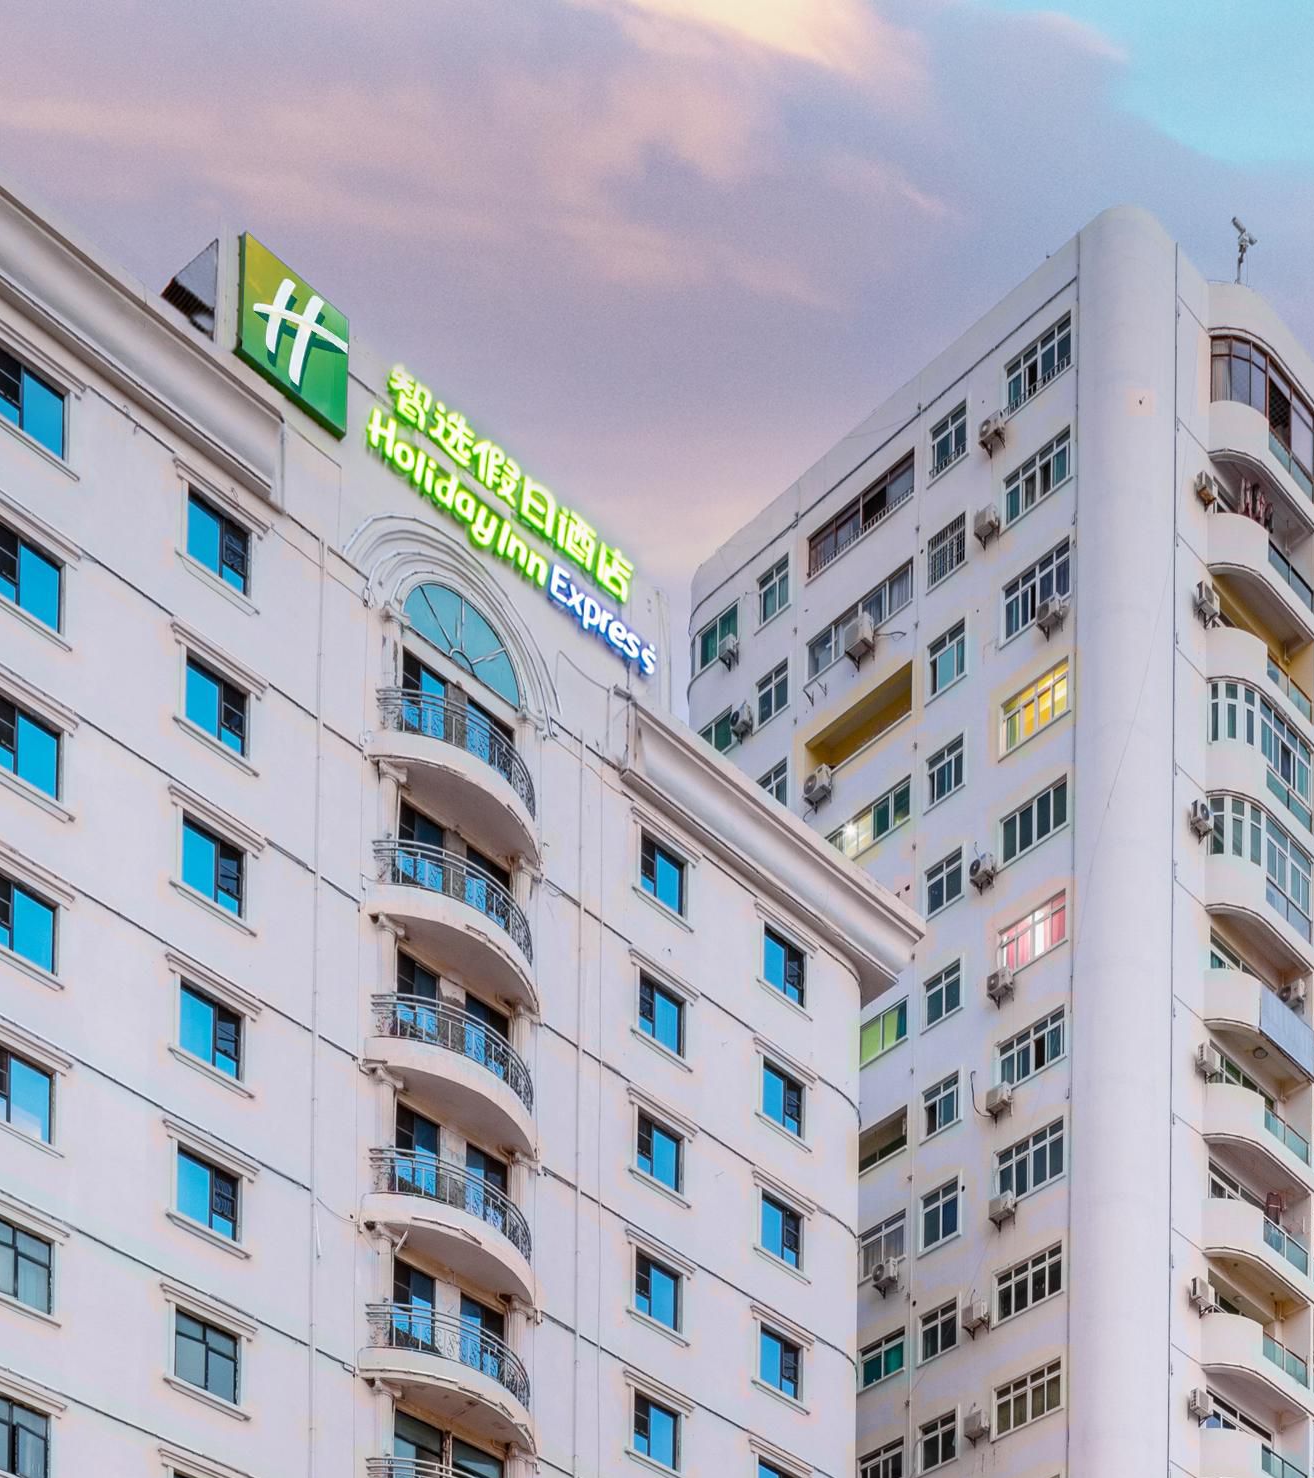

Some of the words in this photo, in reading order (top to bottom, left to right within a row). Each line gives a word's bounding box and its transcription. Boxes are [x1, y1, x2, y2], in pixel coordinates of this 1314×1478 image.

[367, 407, 498, 546] Holiday
[497, 520, 550, 588] Inn
[549, 564, 657, 676] Express
[389, 365, 635, 603] 智选假日酒店
